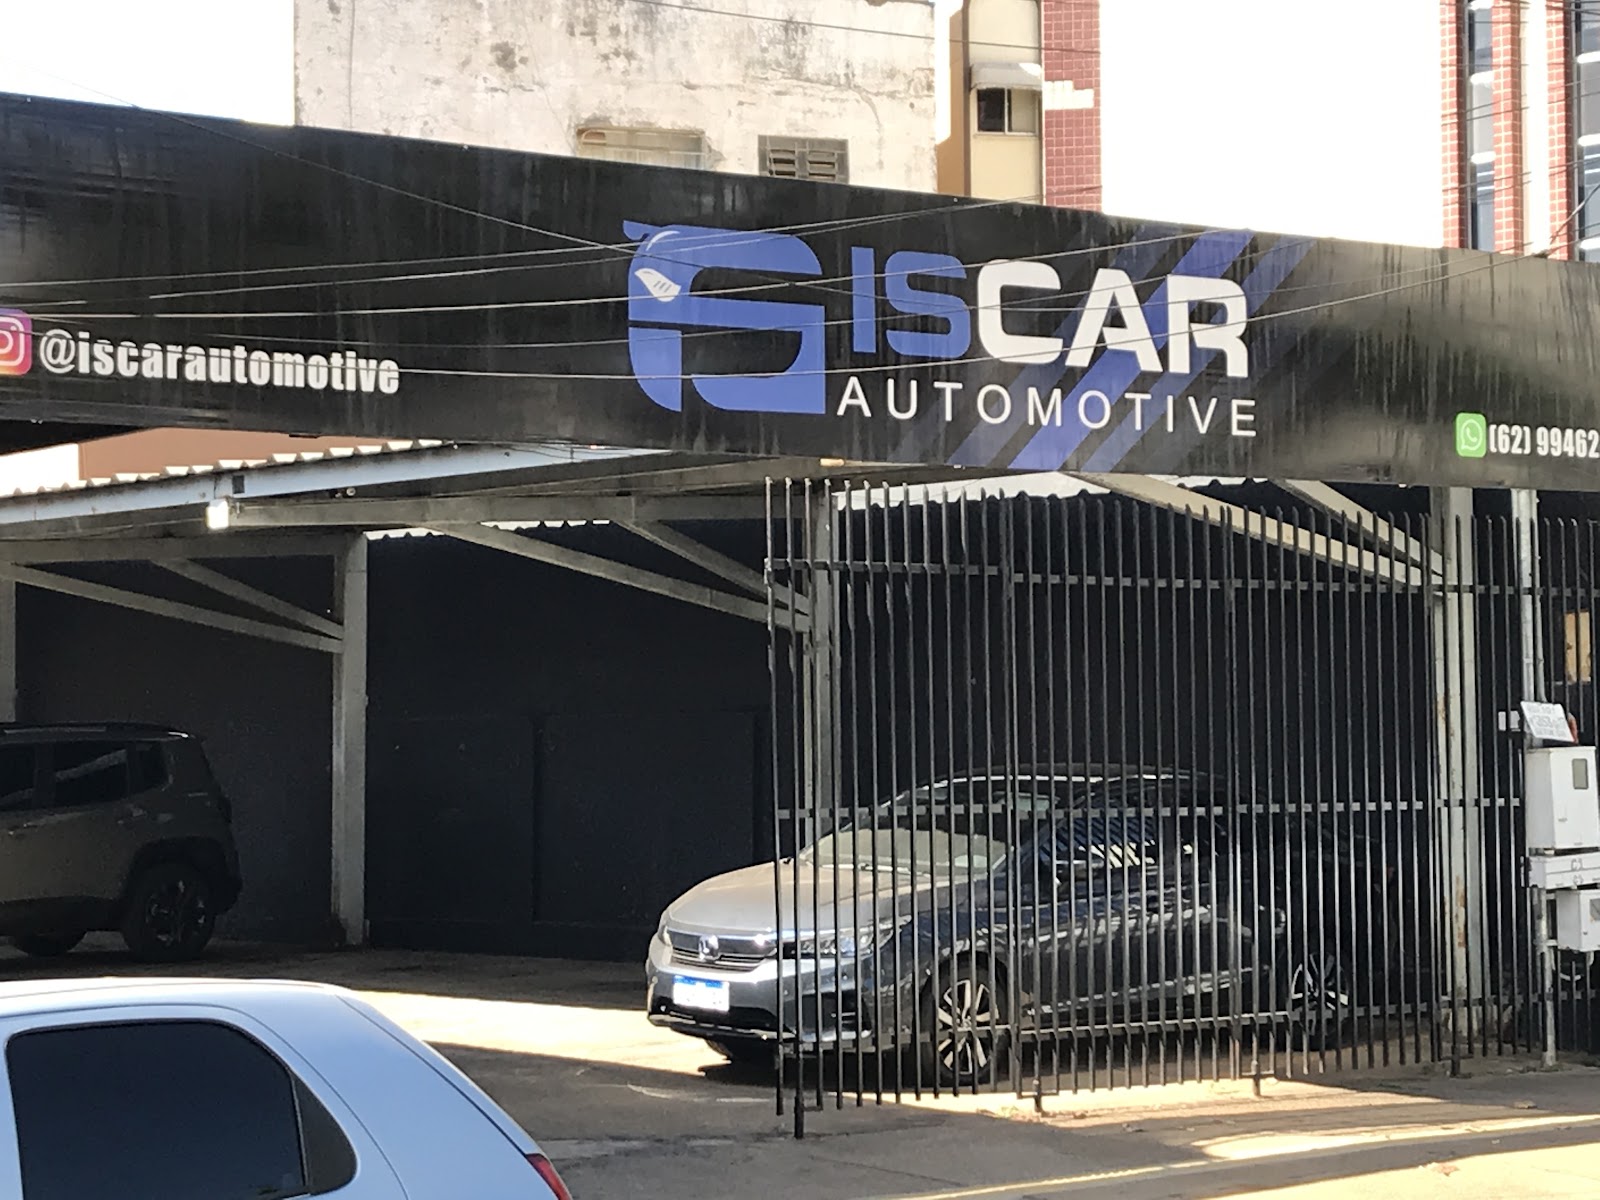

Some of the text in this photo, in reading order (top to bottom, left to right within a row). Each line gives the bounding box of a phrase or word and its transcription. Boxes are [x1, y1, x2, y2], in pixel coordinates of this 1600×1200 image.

[39, 329, 400, 394] @iscarautomotive
[837, 375, 1257, 437] AUTOMOTIVE
[1488, 424, 1600, 459] (62) 99462
